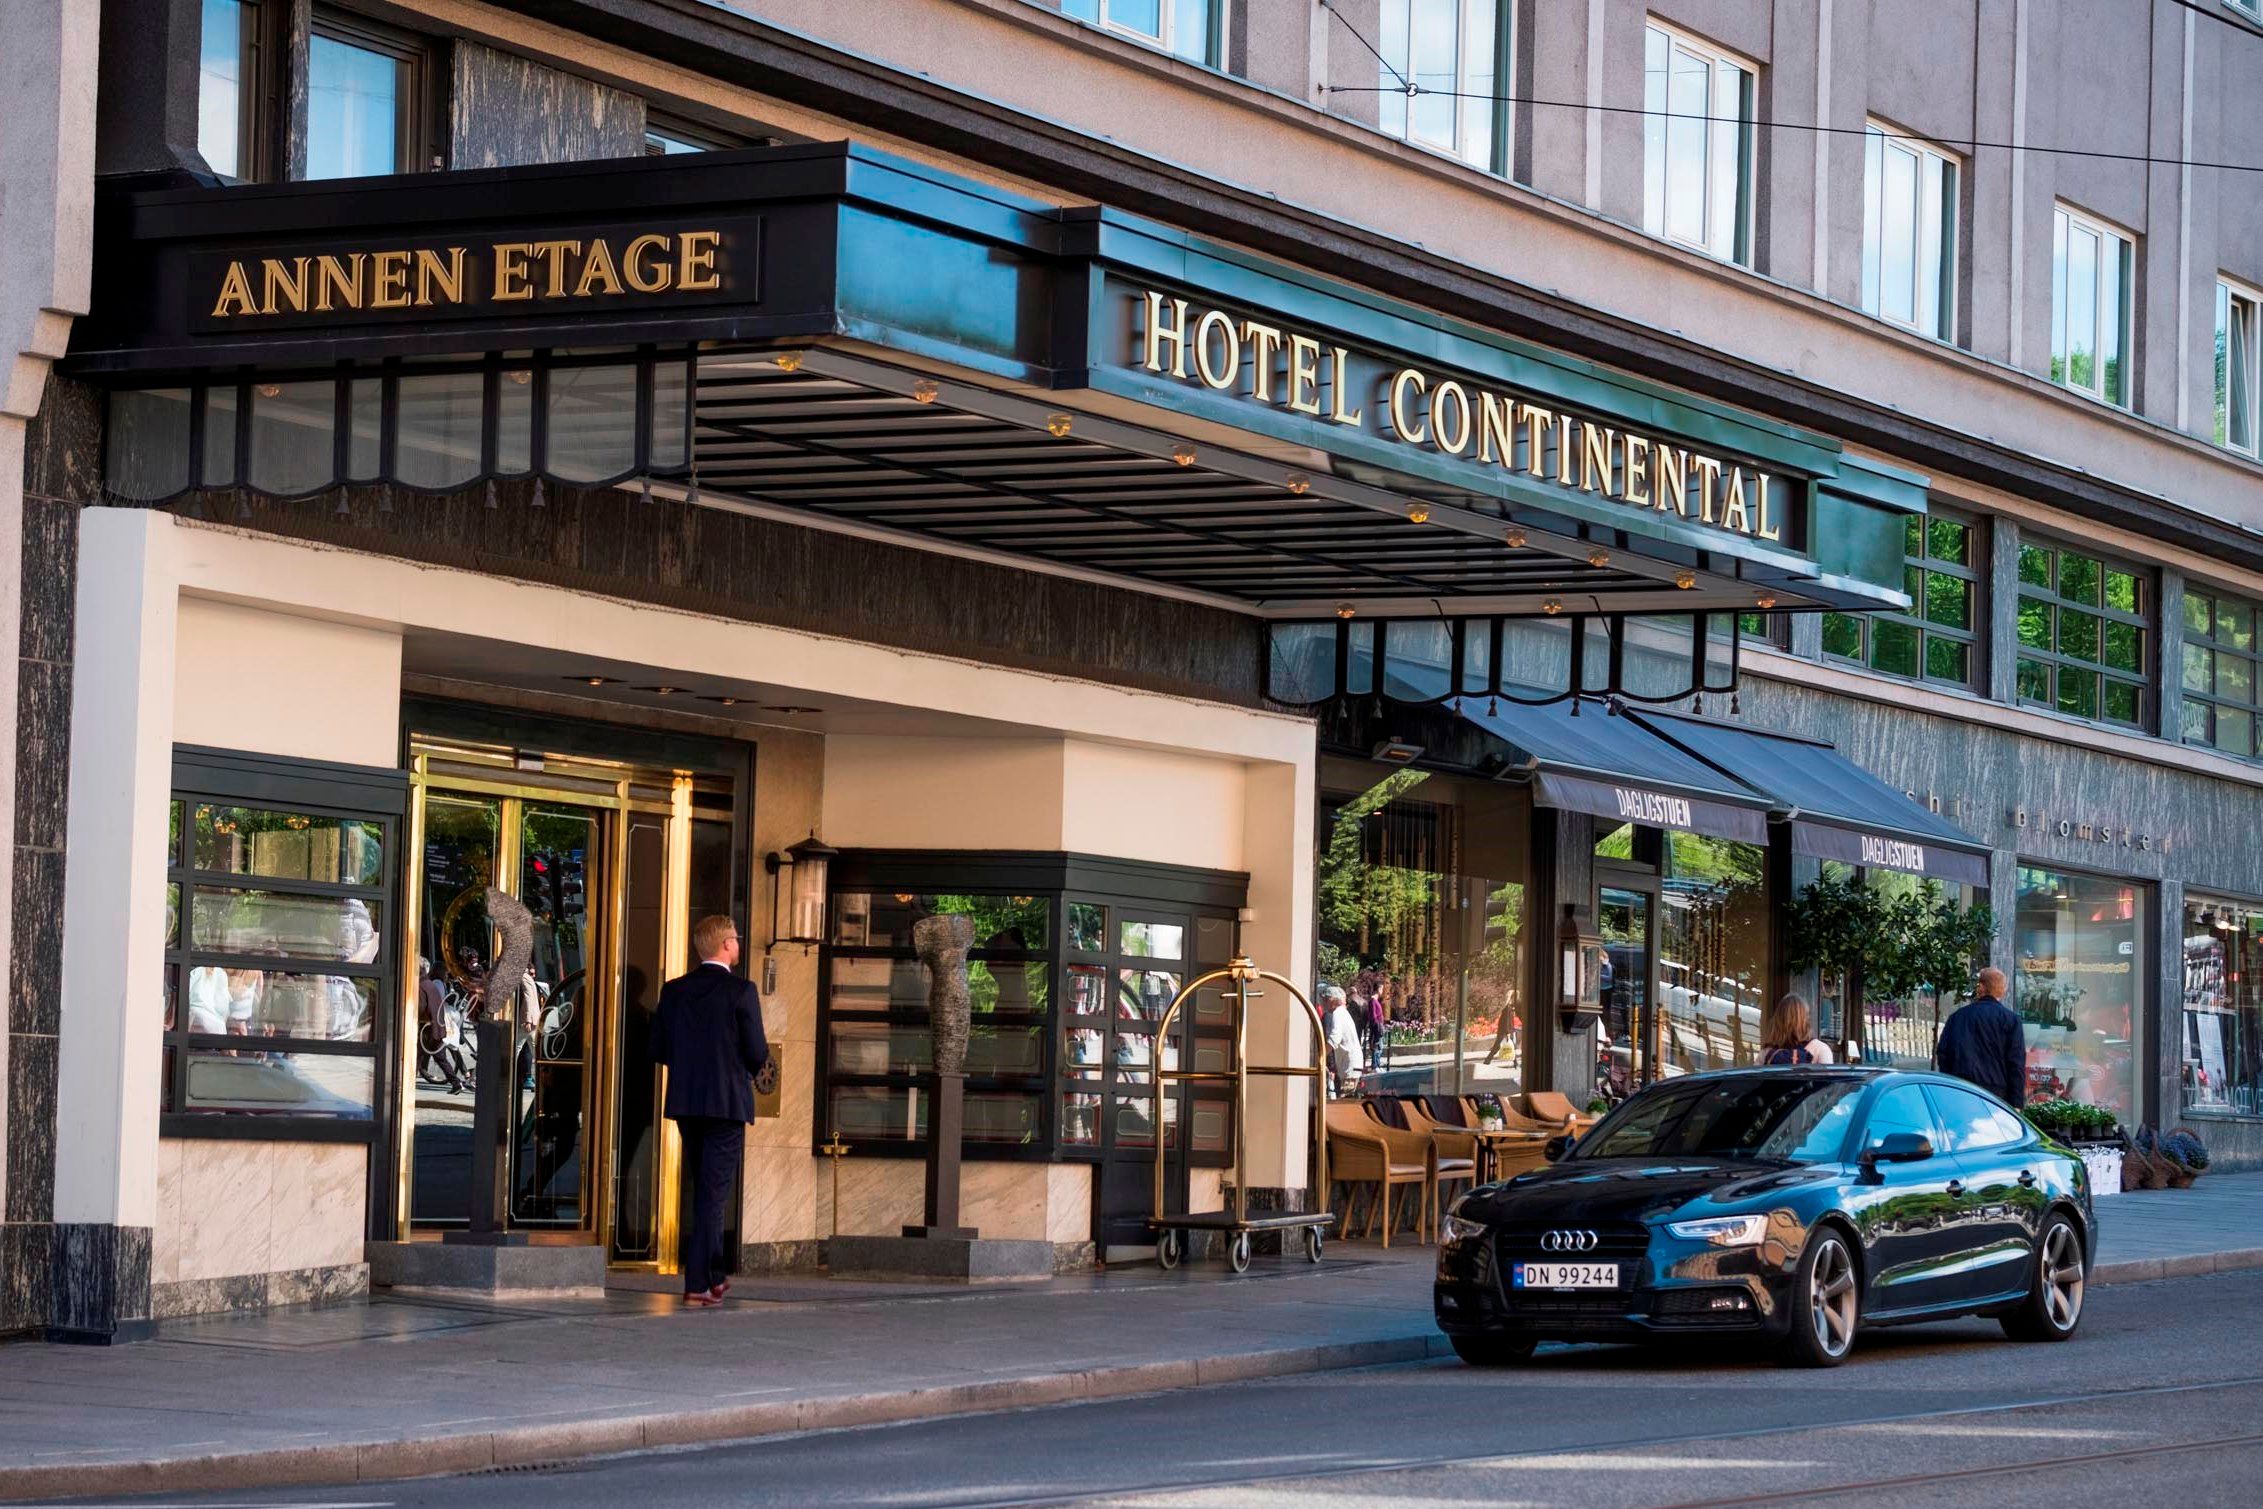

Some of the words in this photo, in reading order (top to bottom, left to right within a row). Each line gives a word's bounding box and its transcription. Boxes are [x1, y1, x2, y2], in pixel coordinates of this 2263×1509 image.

[211, 246, 467, 317] ANNEN
[491, 231, 720, 300] ETAGE
[1143, 290, 1362, 428] HOTEL
[1390, 368, 1780, 542] CONTINENTAL
[1615, 787, 1692, 828] DAGLIGSTUEN
[2012, 804, 2172, 854] blomster
[1861, 835, 1924, 872] DAGLIGSTUEN
[1526, 1267, 1550, 1284] DN
[1558, 1266, 1614, 1284] 99244
